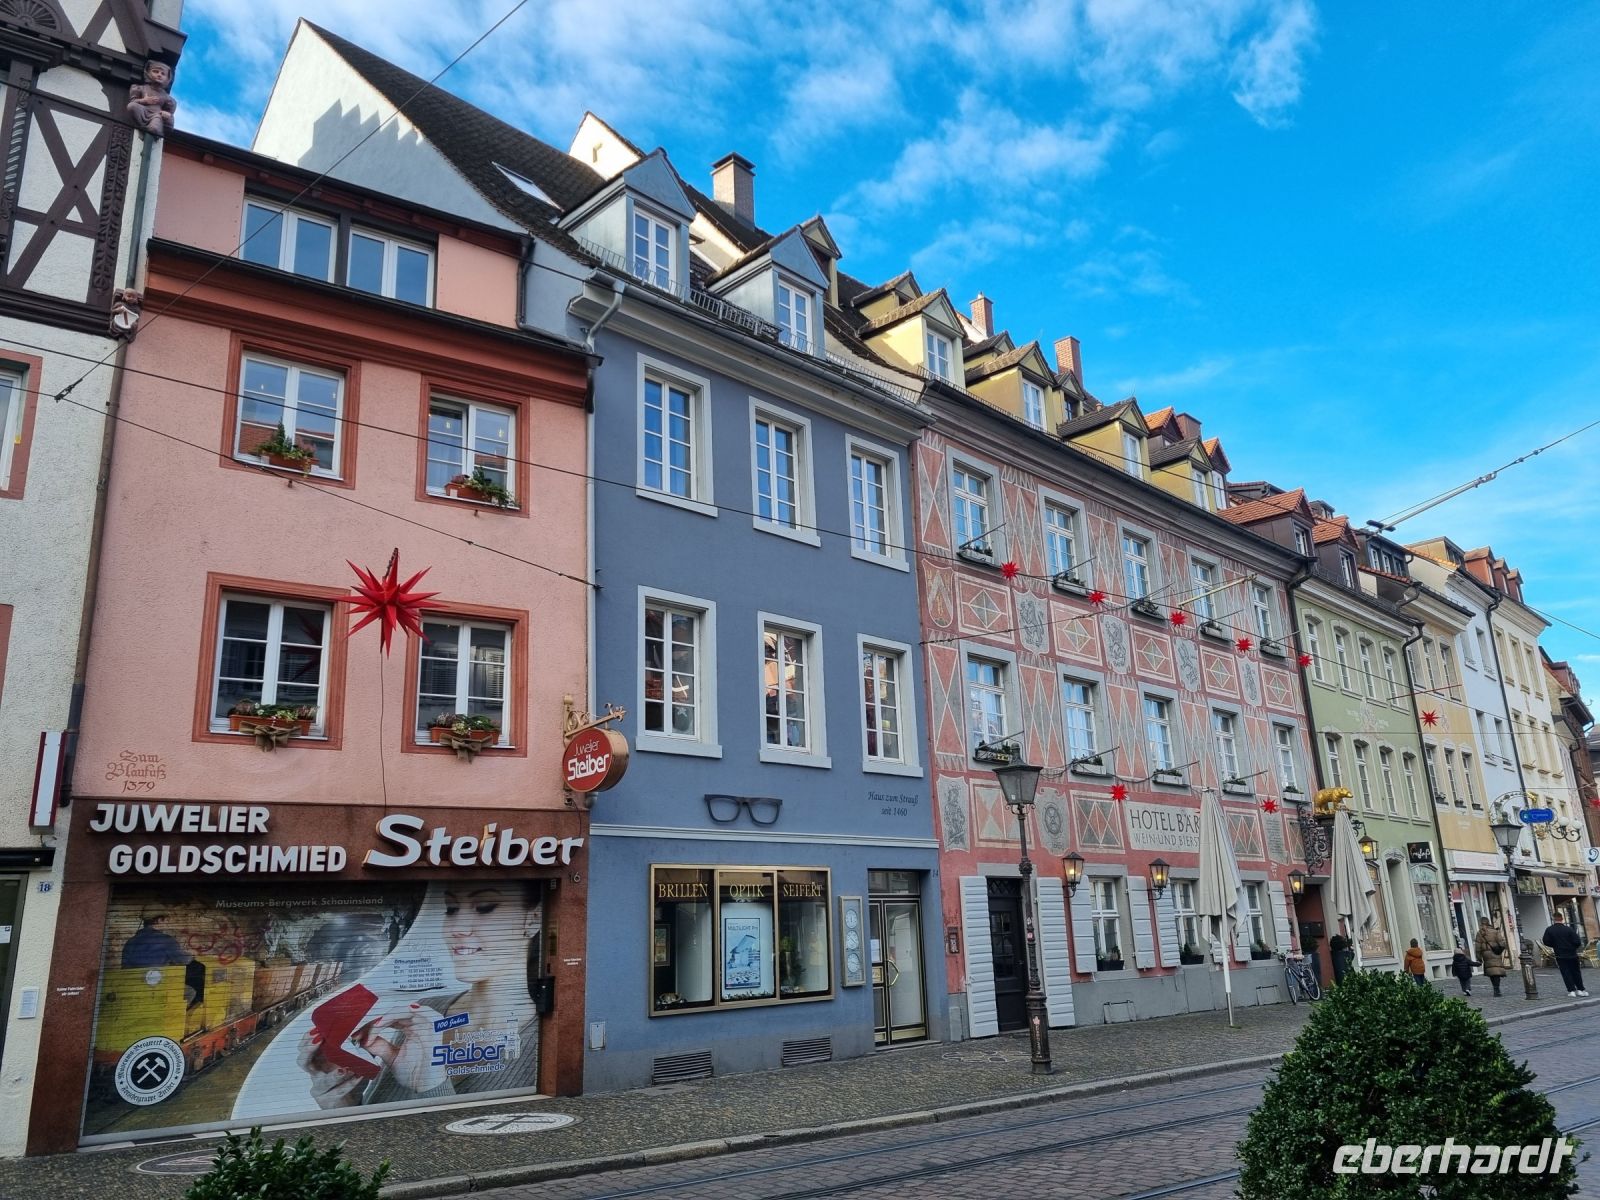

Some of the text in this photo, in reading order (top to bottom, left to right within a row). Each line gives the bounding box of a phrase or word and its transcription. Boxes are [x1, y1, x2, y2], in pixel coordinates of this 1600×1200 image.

[119, 749, 162, 763] Zum
[567, 753, 610, 781] Steiber
[121, 780, 156, 793] 1379
[89, 803, 270, 833] JUWELIER
[1129, 809, 1200, 834] HOTEL BÄR
[364, 814, 585, 867] Steiber
[108, 844, 347, 875] GOLDSCHMIED
[569, 871, 581, 883] 16
[39, 882, 51, 893] 18
[658, 883, 708, 898] BRILLEN
[729, 883, 765, 898] OPTIK
[783, 883, 823, 897] SEIFERT
[215, 896, 384, 909] Museums-Bergwerk Schauinsland
[436, 1020, 449, 1030] 100
[431, 1041, 506, 1067] Steiber
[446, 1063, 506, 1076] Goldschmiede
